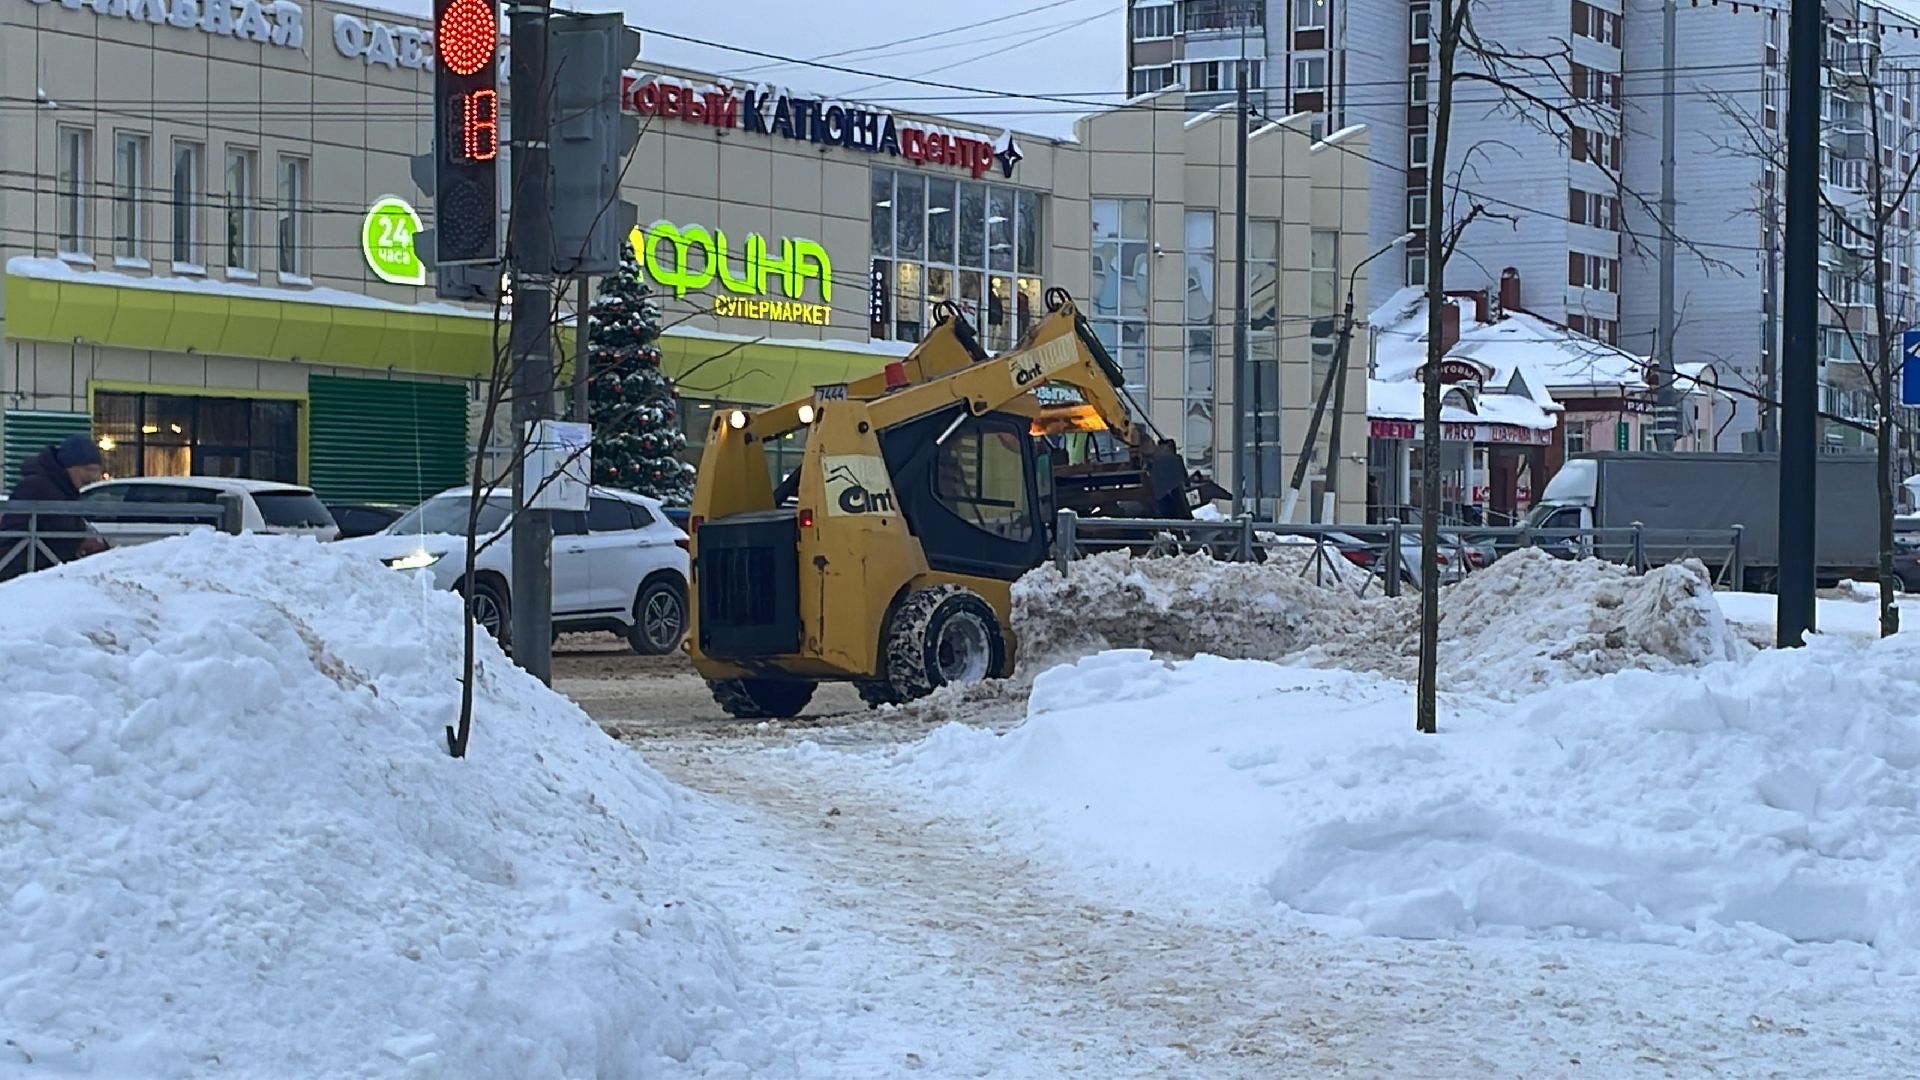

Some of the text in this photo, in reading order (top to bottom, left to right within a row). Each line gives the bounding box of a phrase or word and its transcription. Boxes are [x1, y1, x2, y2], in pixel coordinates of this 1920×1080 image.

[26, 0, 304, 49] ЛЬНАЯ
[464, 90, 496, 160] 18
[743, 86, 903, 157] КАТЮША
[378, 214, 410, 249] 24
[378, 248, 411, 265] часа
[715, 295, 832, 326] СУПЕРМАРКЕТ
[1444, 424, 1476, 440] МЯСО
